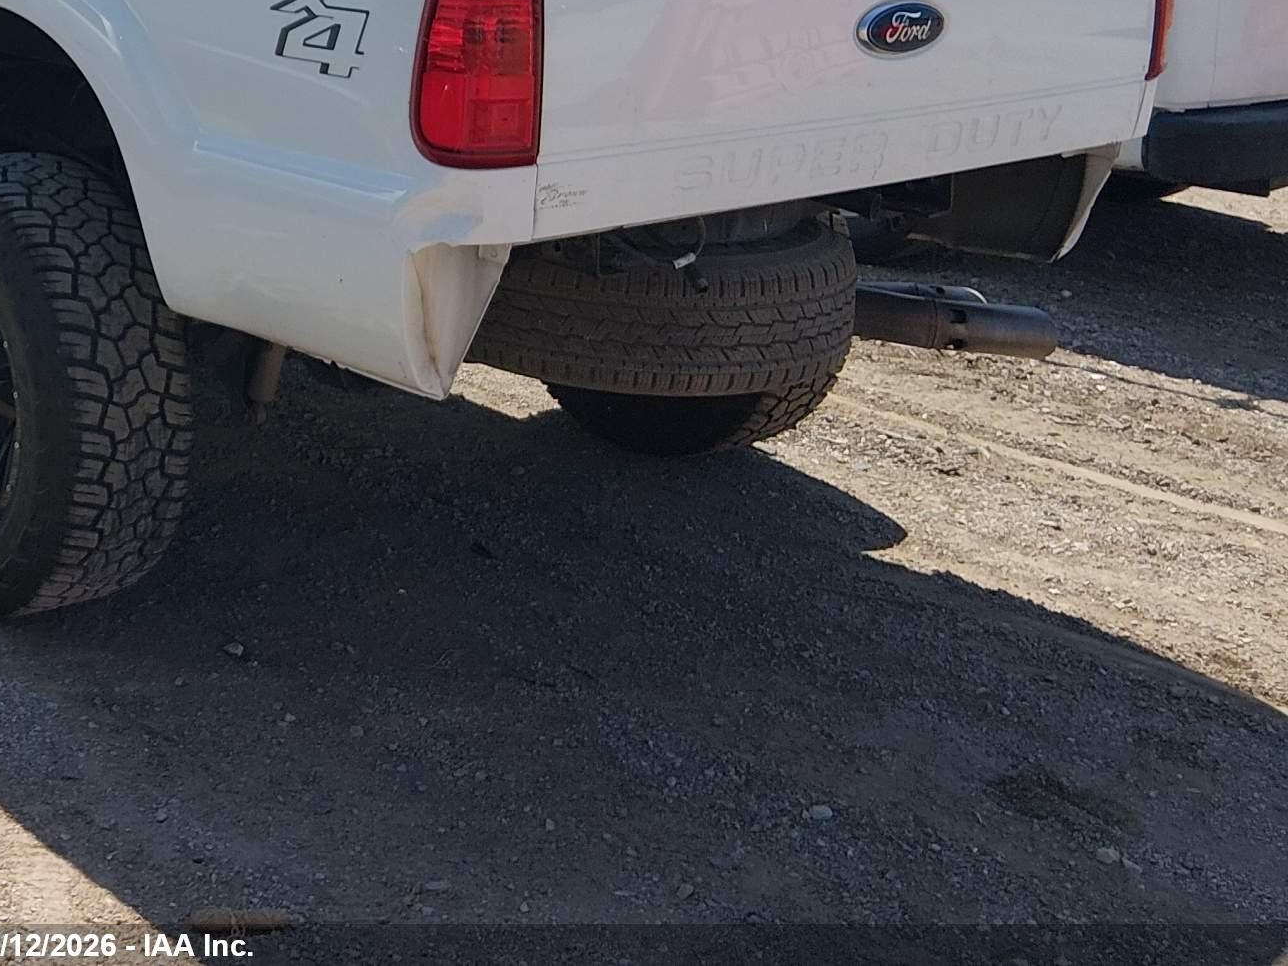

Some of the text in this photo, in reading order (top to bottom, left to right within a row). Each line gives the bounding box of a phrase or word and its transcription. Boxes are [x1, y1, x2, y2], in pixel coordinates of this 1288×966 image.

[885, 11, 932, 44] Ford
[672, 104, 1064, 192] SUPER DUTY
